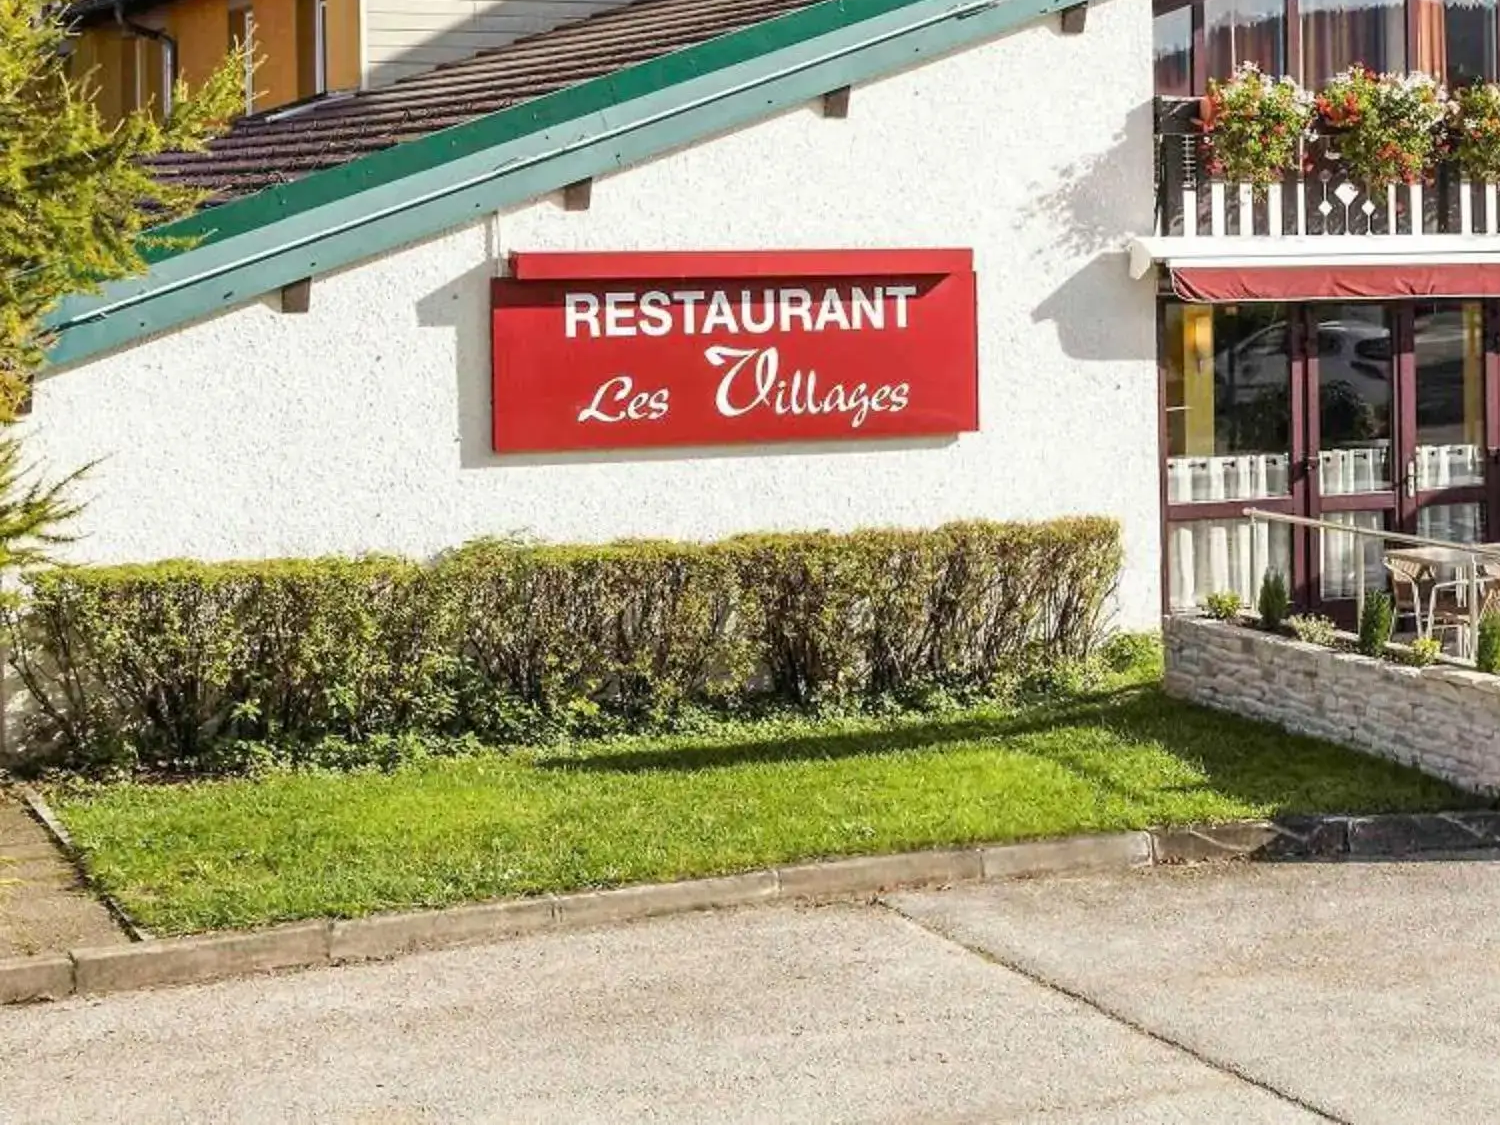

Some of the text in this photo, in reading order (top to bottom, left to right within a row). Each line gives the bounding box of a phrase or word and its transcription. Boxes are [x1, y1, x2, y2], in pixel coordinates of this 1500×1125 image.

[564, 285, 917, 338] RESTAURANT
[576, 345, 910, 428] Les Villages
